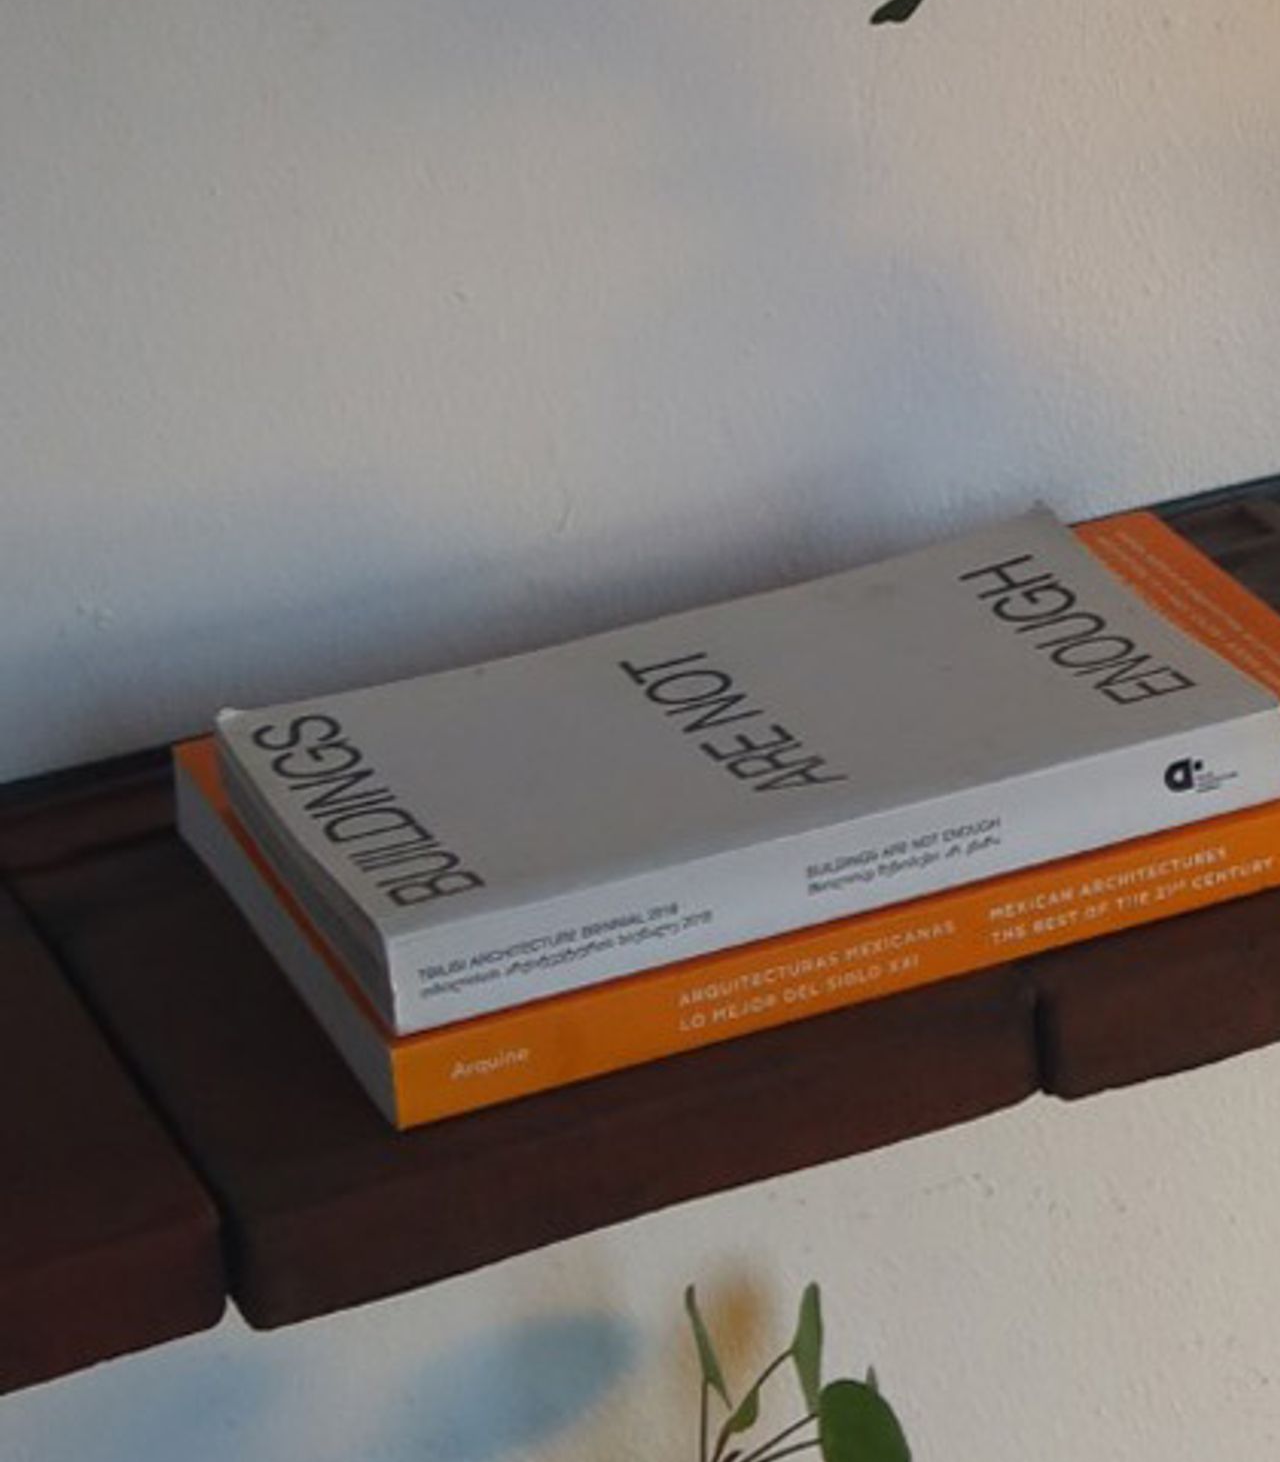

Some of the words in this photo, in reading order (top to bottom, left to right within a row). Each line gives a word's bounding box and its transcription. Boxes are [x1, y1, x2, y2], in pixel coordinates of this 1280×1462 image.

[958, 553, 1197, 705] ENOUGH
[618, 651, 765, 734] NOT
[700, 723, 849, 792] ARE
[252, 714, 486, 907] BUILDINGS
[806, 850, 879, 878] BUILDINGS
[881, 841, 907, 858] ARE
[911, 832, 938, 850] NOT
[942, 817, 1001, 843] ENOUGH
[989, 887, 1074, 921] MEXICAN
[1079, 846, 1227, 898] ARCHITECTURES
[992, 920, 1026, 944] THE
[1033, 910, 1079, 934] BEST
[1086, 902, 1109, 919] OF
[1116, 886, 1149, 911] THE
[1191, 856, 1274, 890] CENTURY
[470, 928, 577, 969] ARCHITECTURE
[679, 952, 839, 1007] ARQUITECTURAS
[845, 920, 955, 962] MEXICANAS
[679, 1016, 706, 1032] LO
[713, 994, 777, 1020] MEJOR
[783, 983, 820, 1004] DEL
[827, 963, 883, 993] SIGLO
[889, 954, 920, 975] XXI
